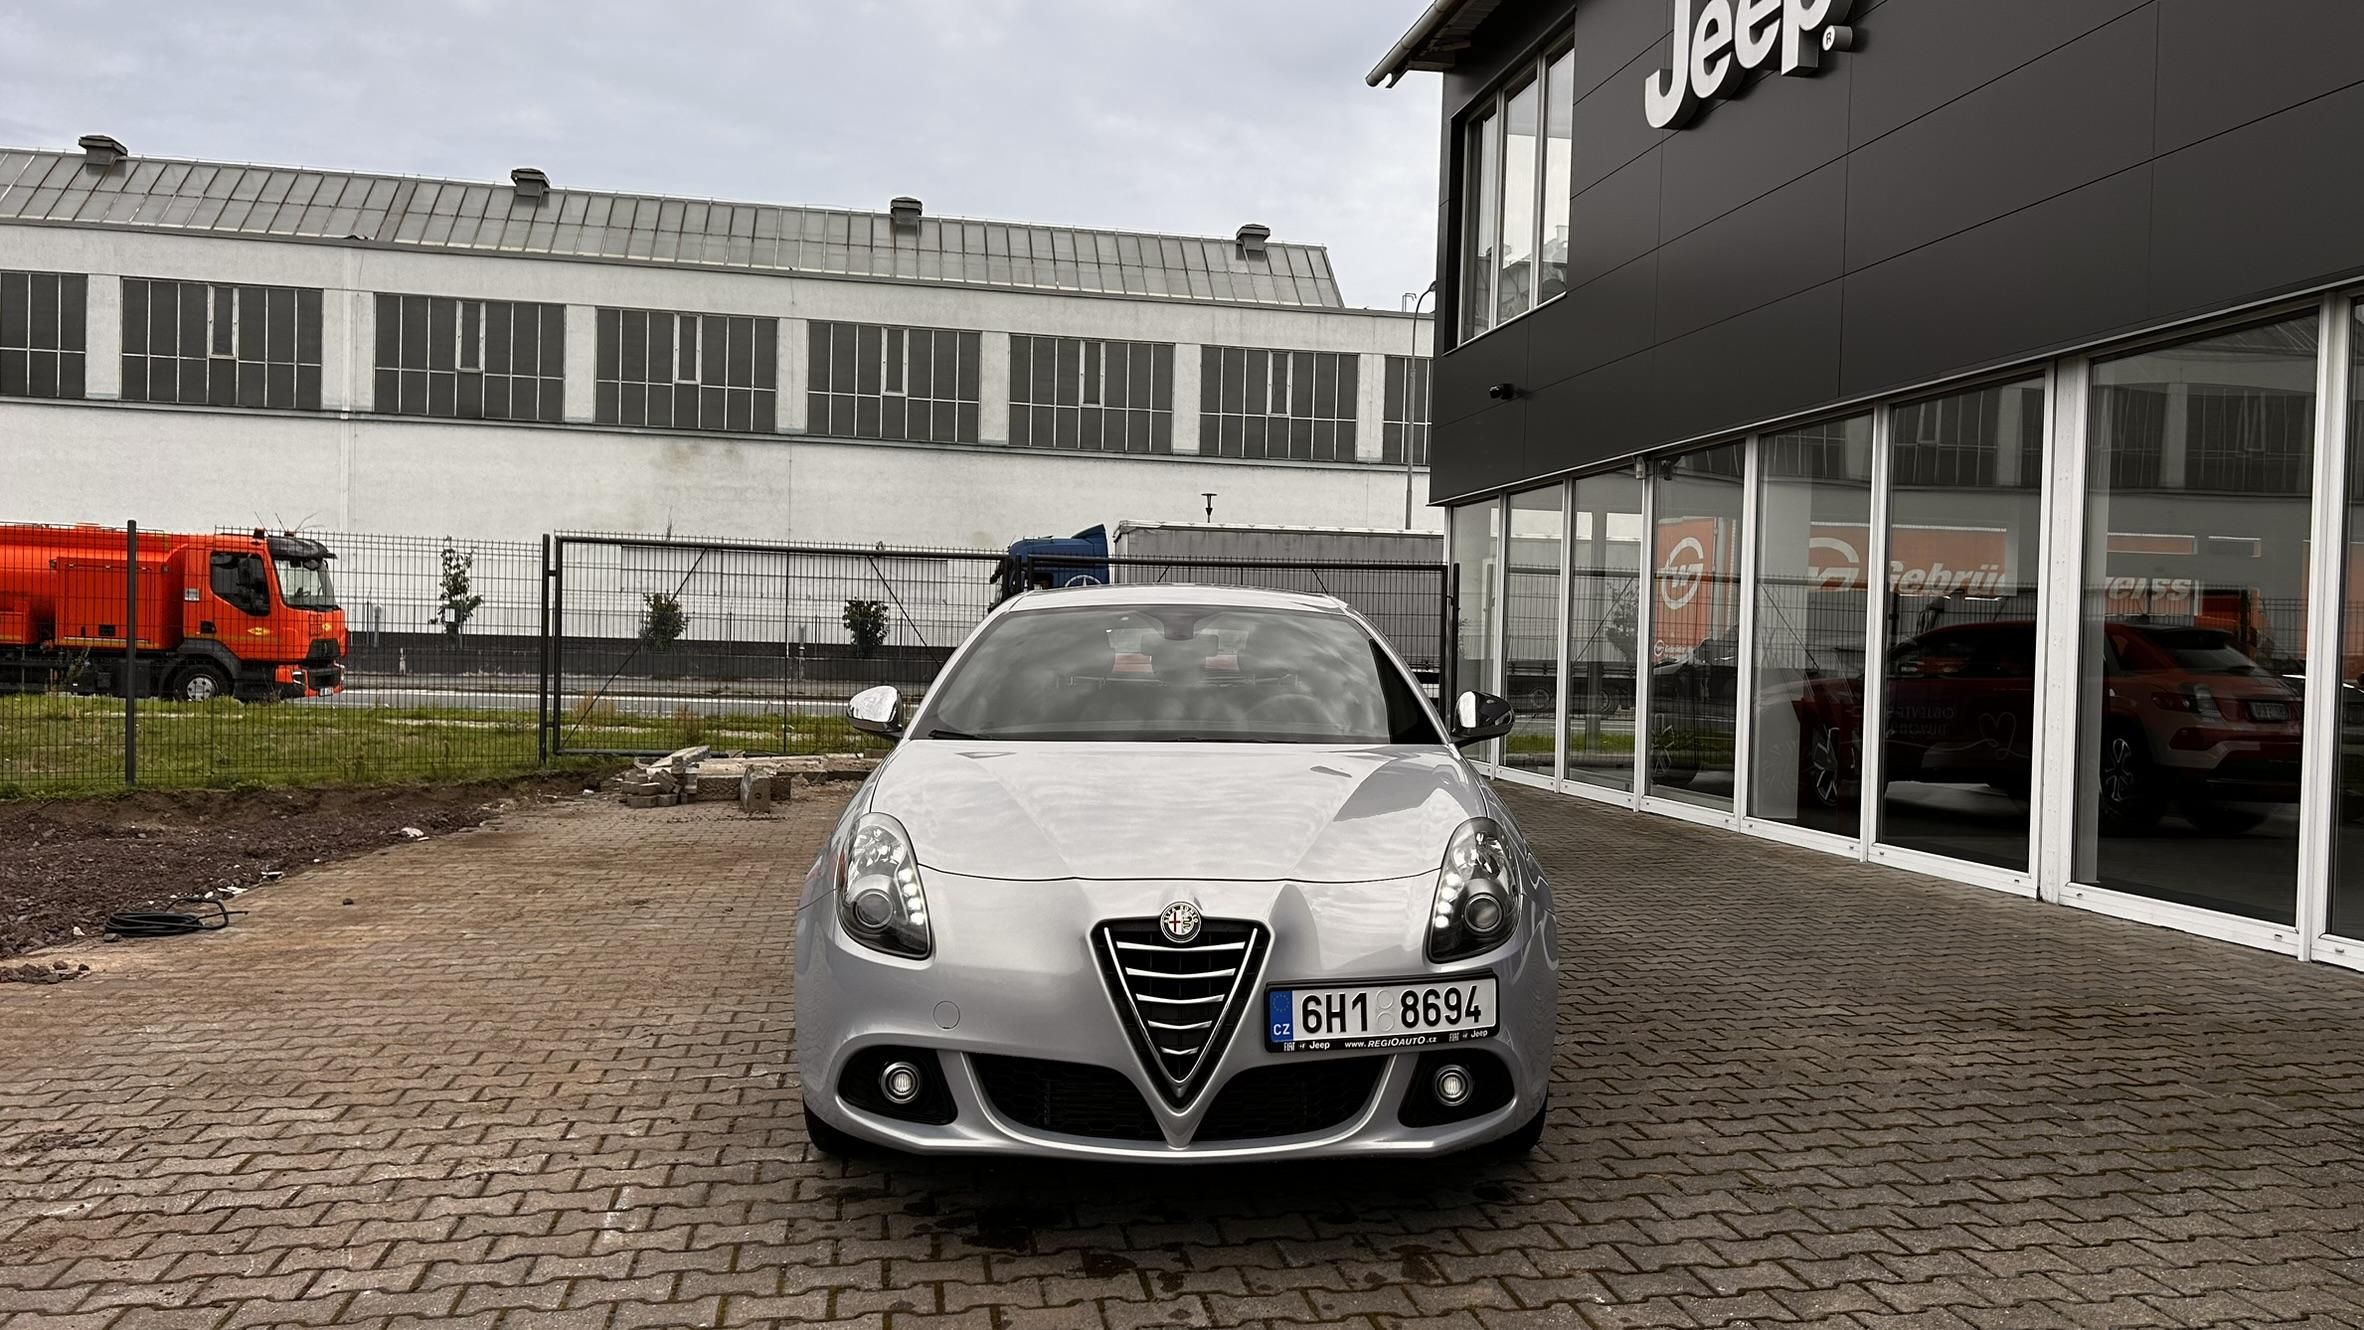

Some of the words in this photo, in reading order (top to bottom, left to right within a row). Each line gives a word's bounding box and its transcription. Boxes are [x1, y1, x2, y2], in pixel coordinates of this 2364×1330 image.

[1302, 992, 1368, 1034] 6H1
[1400, 985, 1482, 1029] 8694
[1273, 1024, 1291, 1036] CZ
[1309, 1041, 1331, 1050] Jeep
[1470, 1029, 1489, 1039] Jeep
